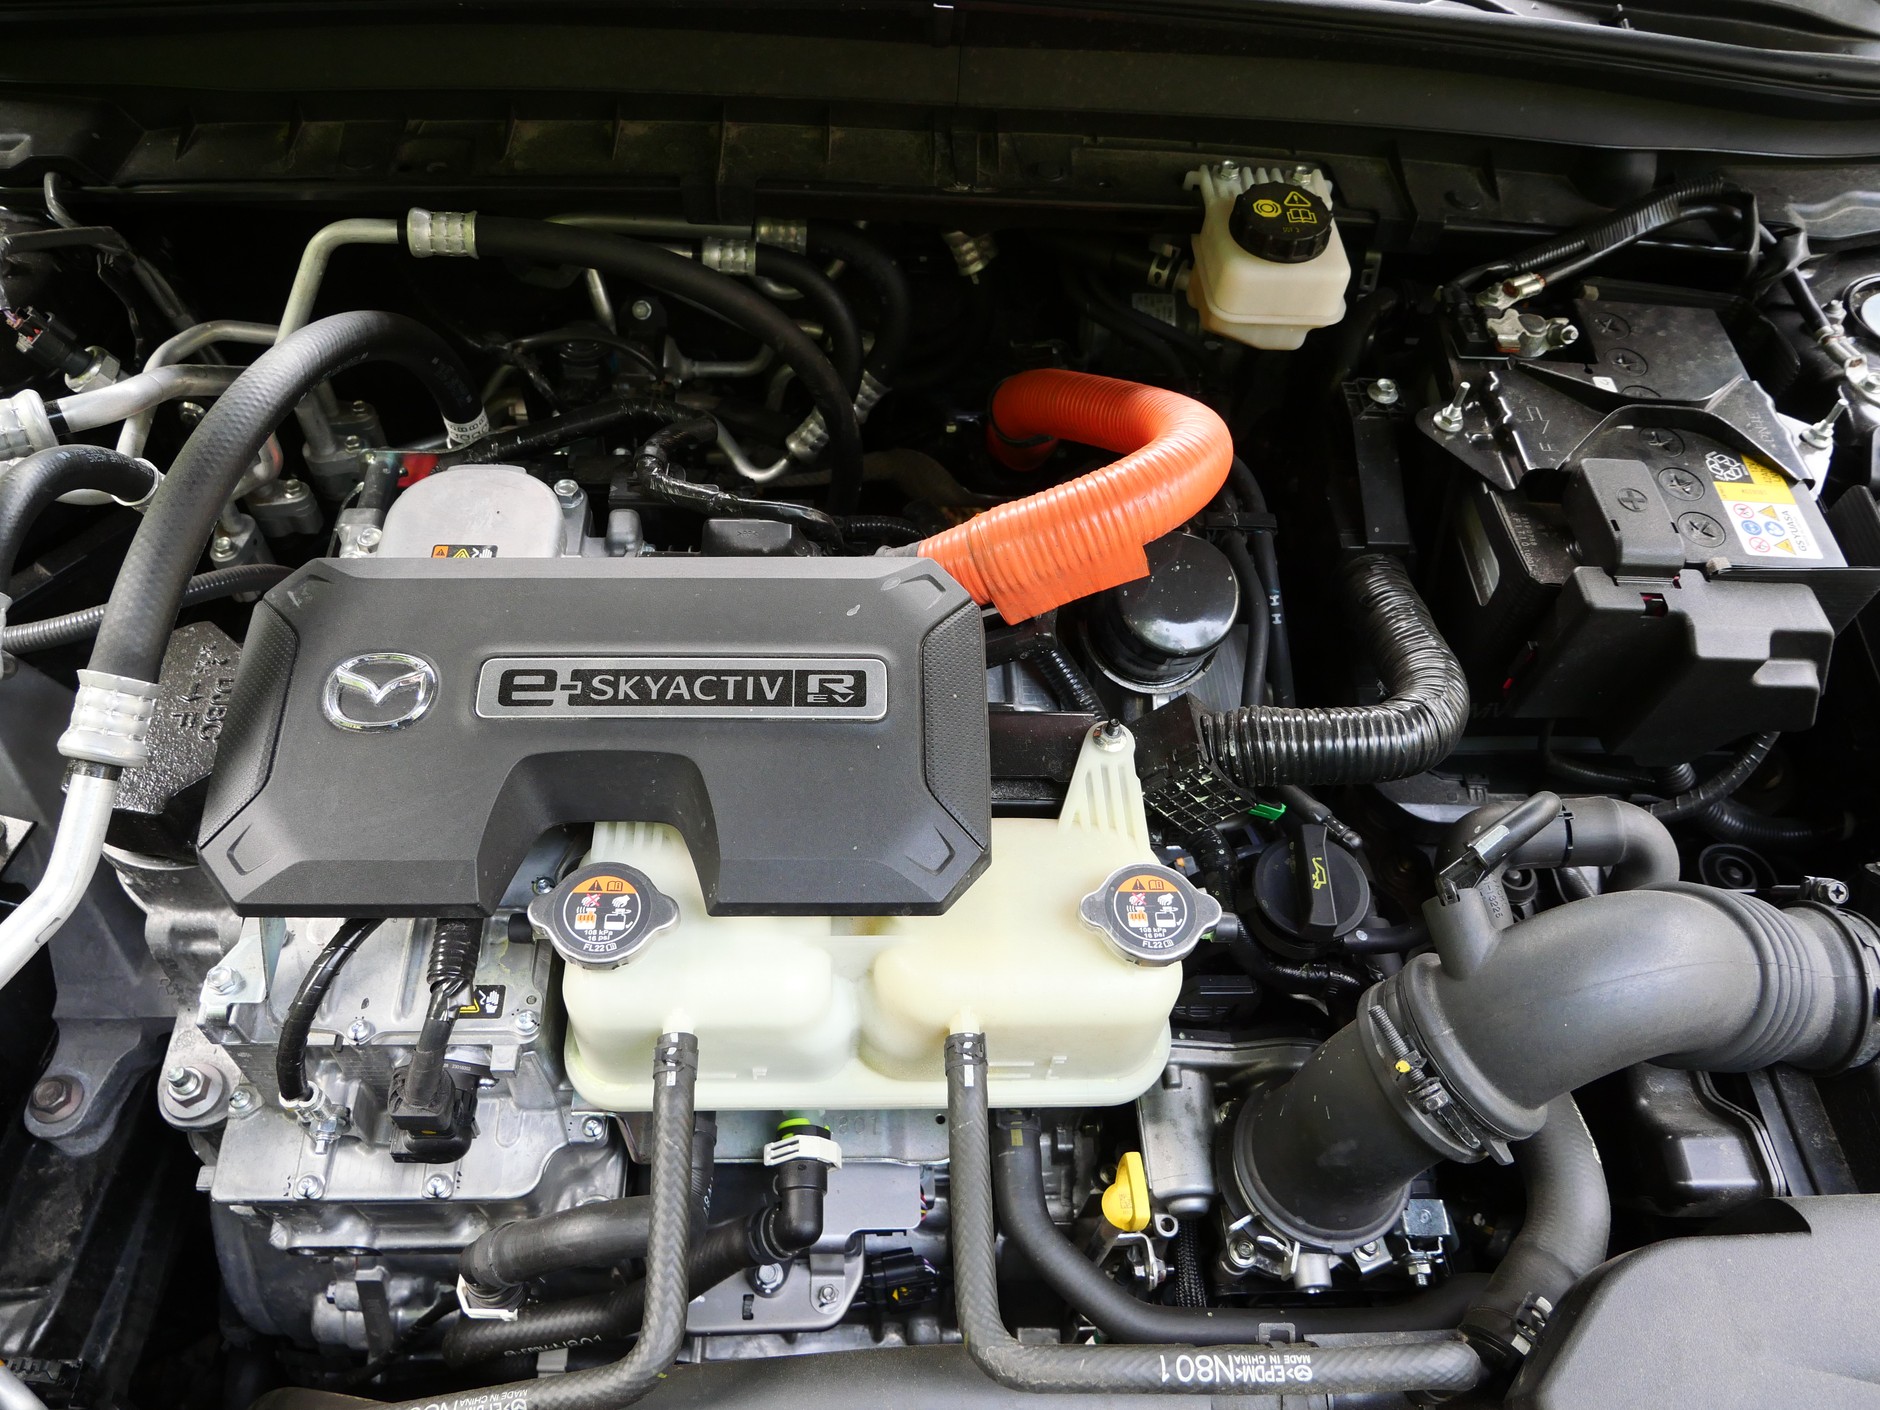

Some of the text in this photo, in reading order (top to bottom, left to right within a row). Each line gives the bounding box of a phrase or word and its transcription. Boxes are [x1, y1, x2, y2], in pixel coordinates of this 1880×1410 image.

[583, 943, 605, 952] FL22
[1142, 940, 1163, 949] FL22
[1233, 1355, 1311, 1364] MADE IN CHINA
[1160, 1354, 1235, 1383] N801
[489, 1393, 500, 1402] IN
[501, 1389, 528, 1401] MADE
[460, 1395, 488, 1407] CHINA
